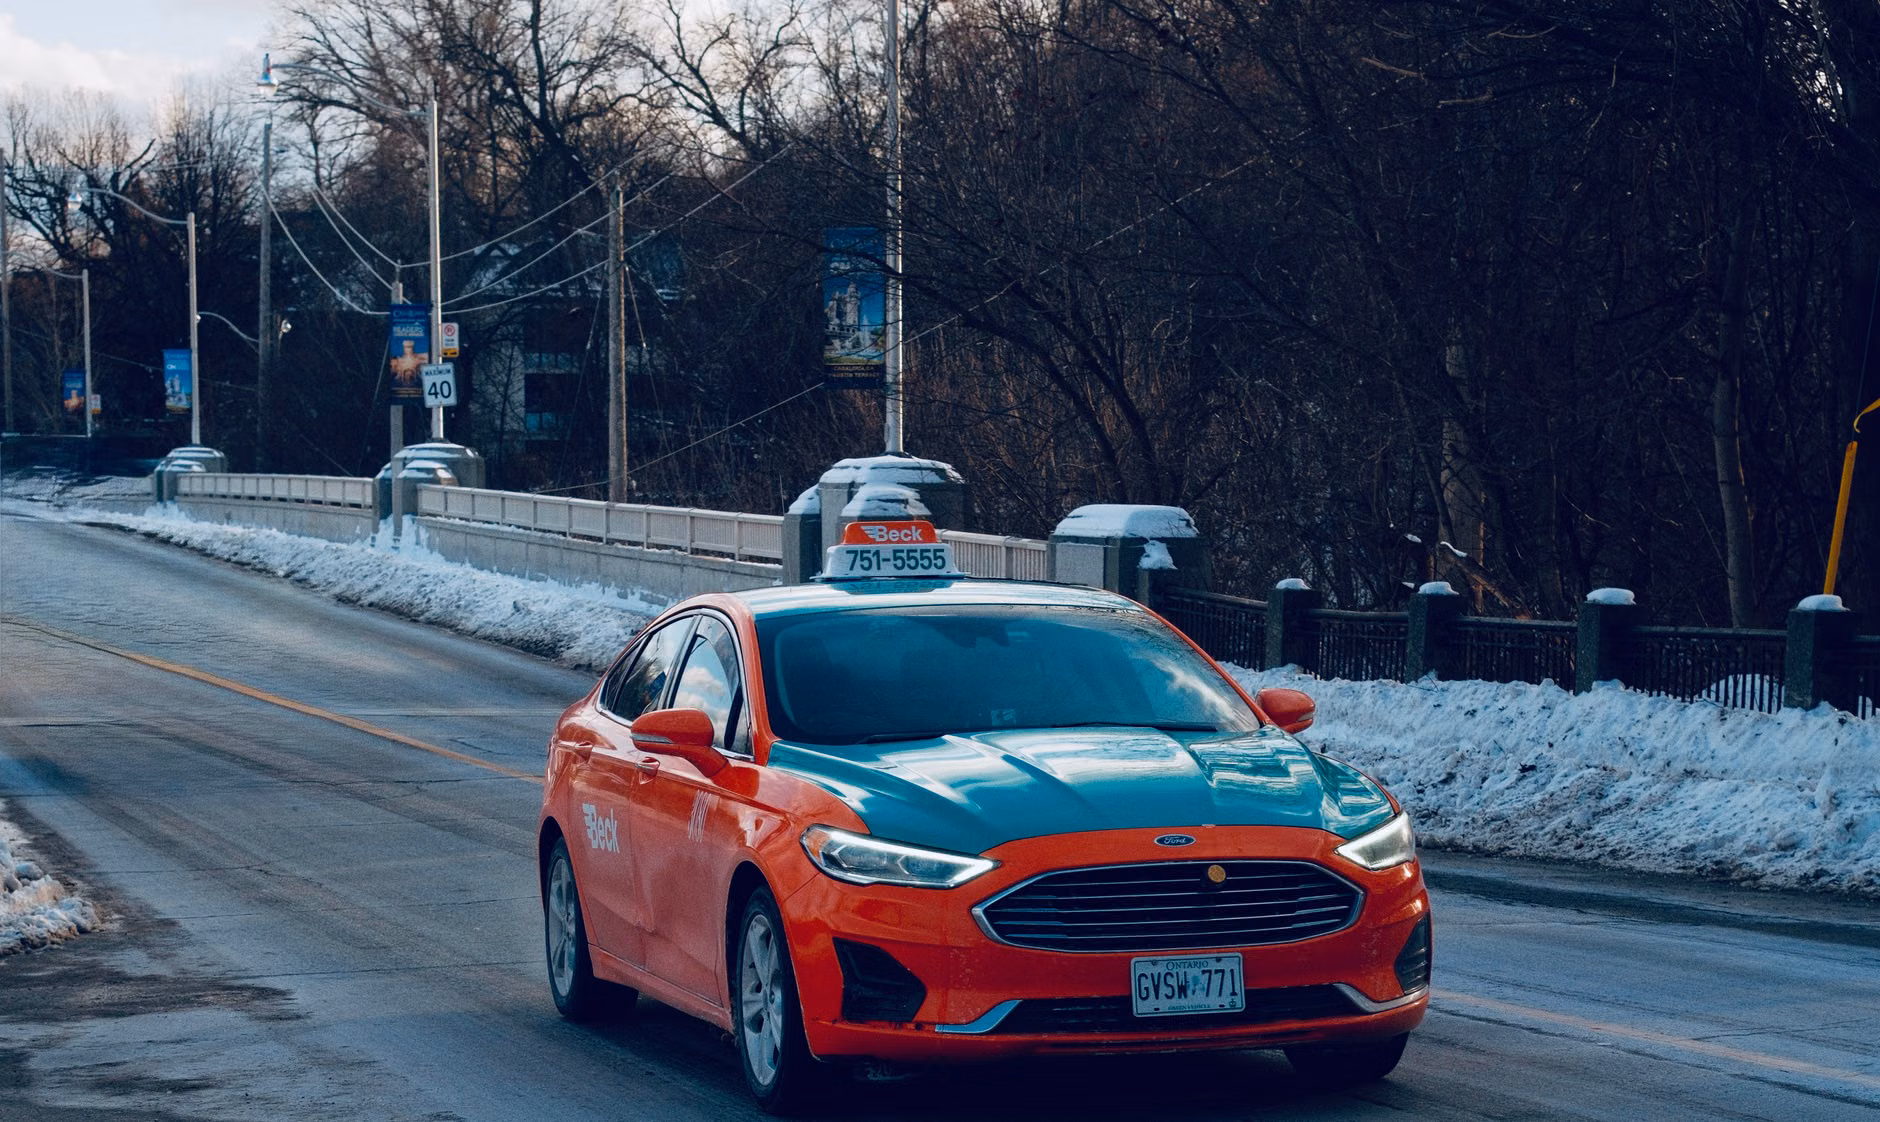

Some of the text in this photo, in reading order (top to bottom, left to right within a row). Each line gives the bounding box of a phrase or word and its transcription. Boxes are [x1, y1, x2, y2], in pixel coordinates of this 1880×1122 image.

[427, 380, 452, 399] 40
[862, 525, 922, 542] Beck
[846, 548, 946, 571] 751-5555
[582, 803, 620, 853] Beck
[1163, 836, 1186, 844] Ford
[1138, 968, 1238, 1001] GVSW 771
